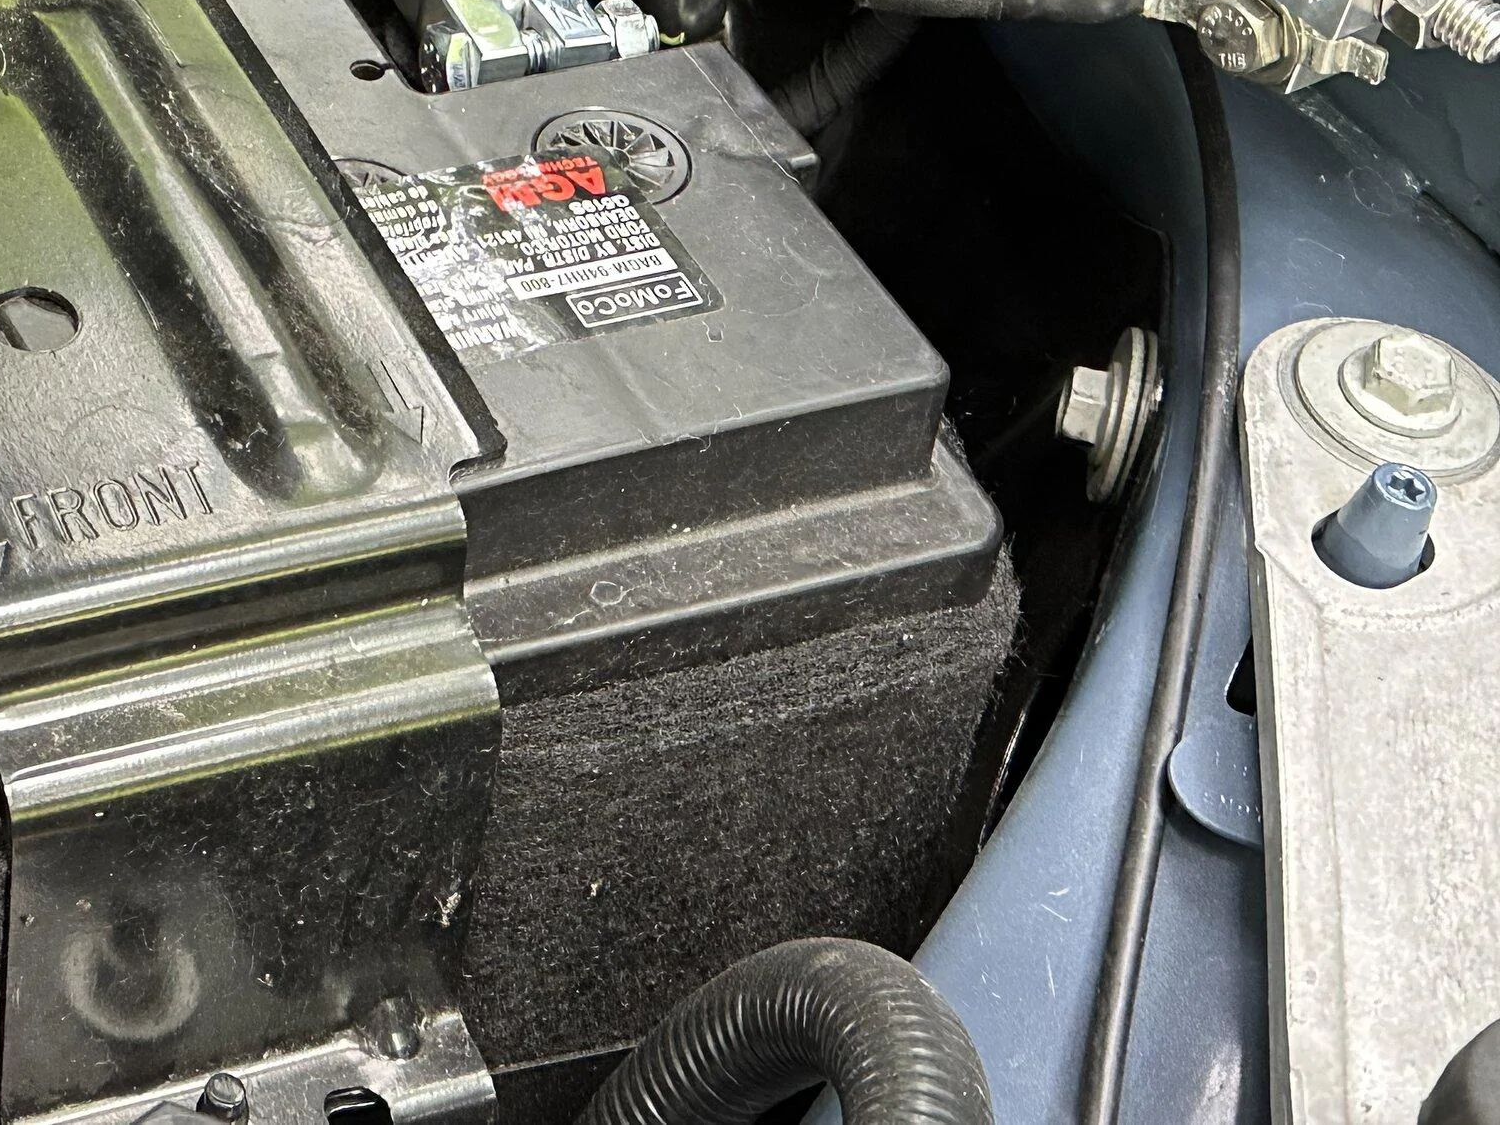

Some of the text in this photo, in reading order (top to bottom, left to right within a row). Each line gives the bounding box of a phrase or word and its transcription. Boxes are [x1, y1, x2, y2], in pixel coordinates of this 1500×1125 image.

[482, 155, 597, 185] TECHNLOGY
[487, 165, 607, 212] AGM
[546, 206, 639, 233] DEARBORN,
[604, 219, 649, 238] FORD
[541, 228, 604, 250] MOTOR
[594, 240, 617, 257] BY
[616, 232, 660, 251] DIST.
[577, 281, 691, 316] FoMoCo
[447, 319, 524, 350] WARNIN
[9, 462, 214, 550] FRONT
